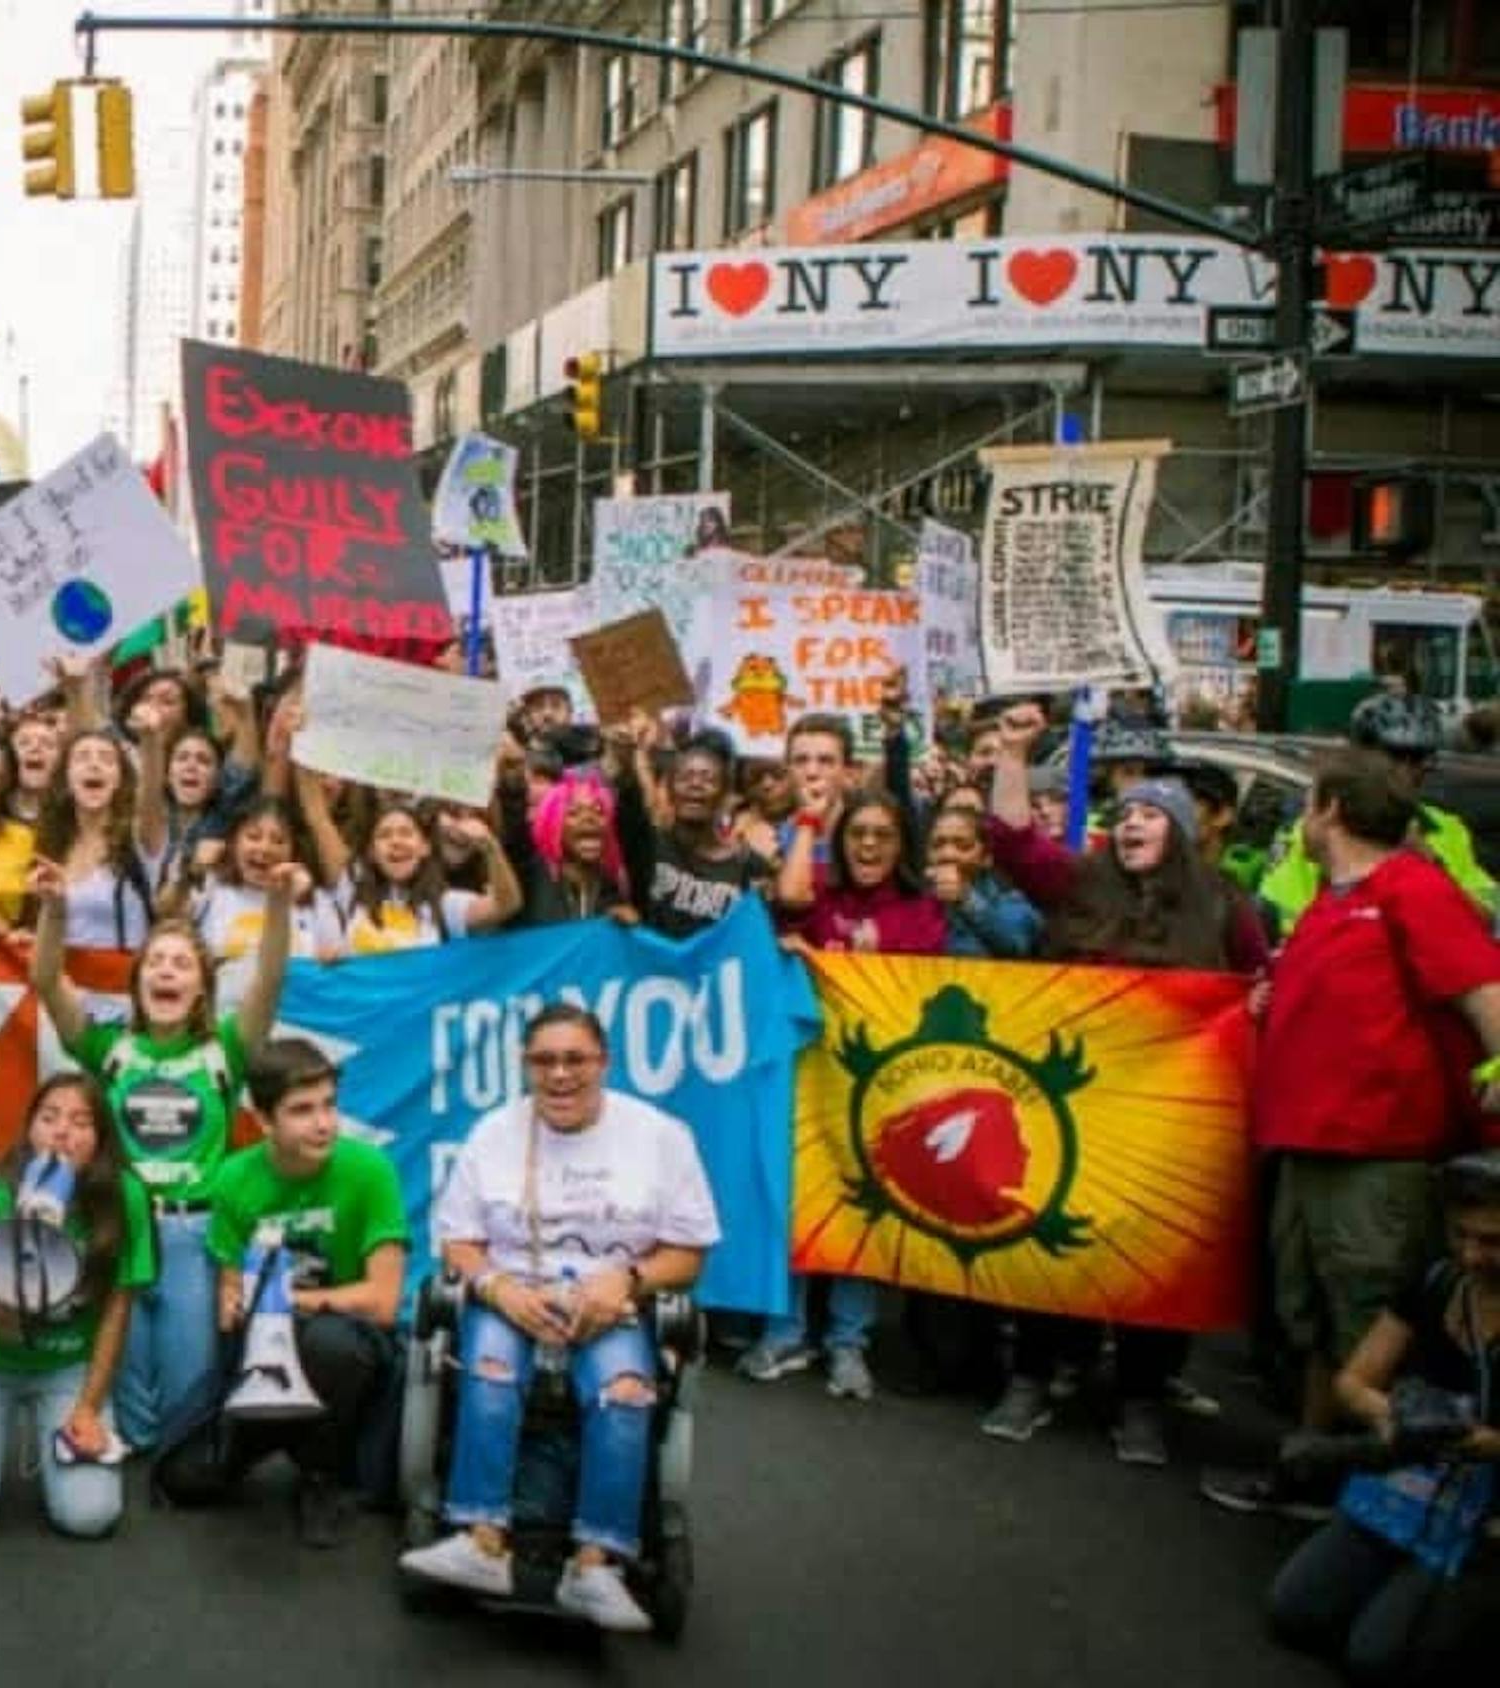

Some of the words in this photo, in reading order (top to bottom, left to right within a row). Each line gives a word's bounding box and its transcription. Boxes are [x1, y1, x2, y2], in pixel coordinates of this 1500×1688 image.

[776, 254, 909, 315] NY
[1082, 245, 1218, 306] NY
[1000, 479, 1116, 517] STRIKE
[737, 596, 775, 630] I
[790, 592, 920, 626] SPEAK
[795, 636, 896, 670] FOR
[806, 675, 885, 707] THE
[556, 957, 750, 1096] YOU
